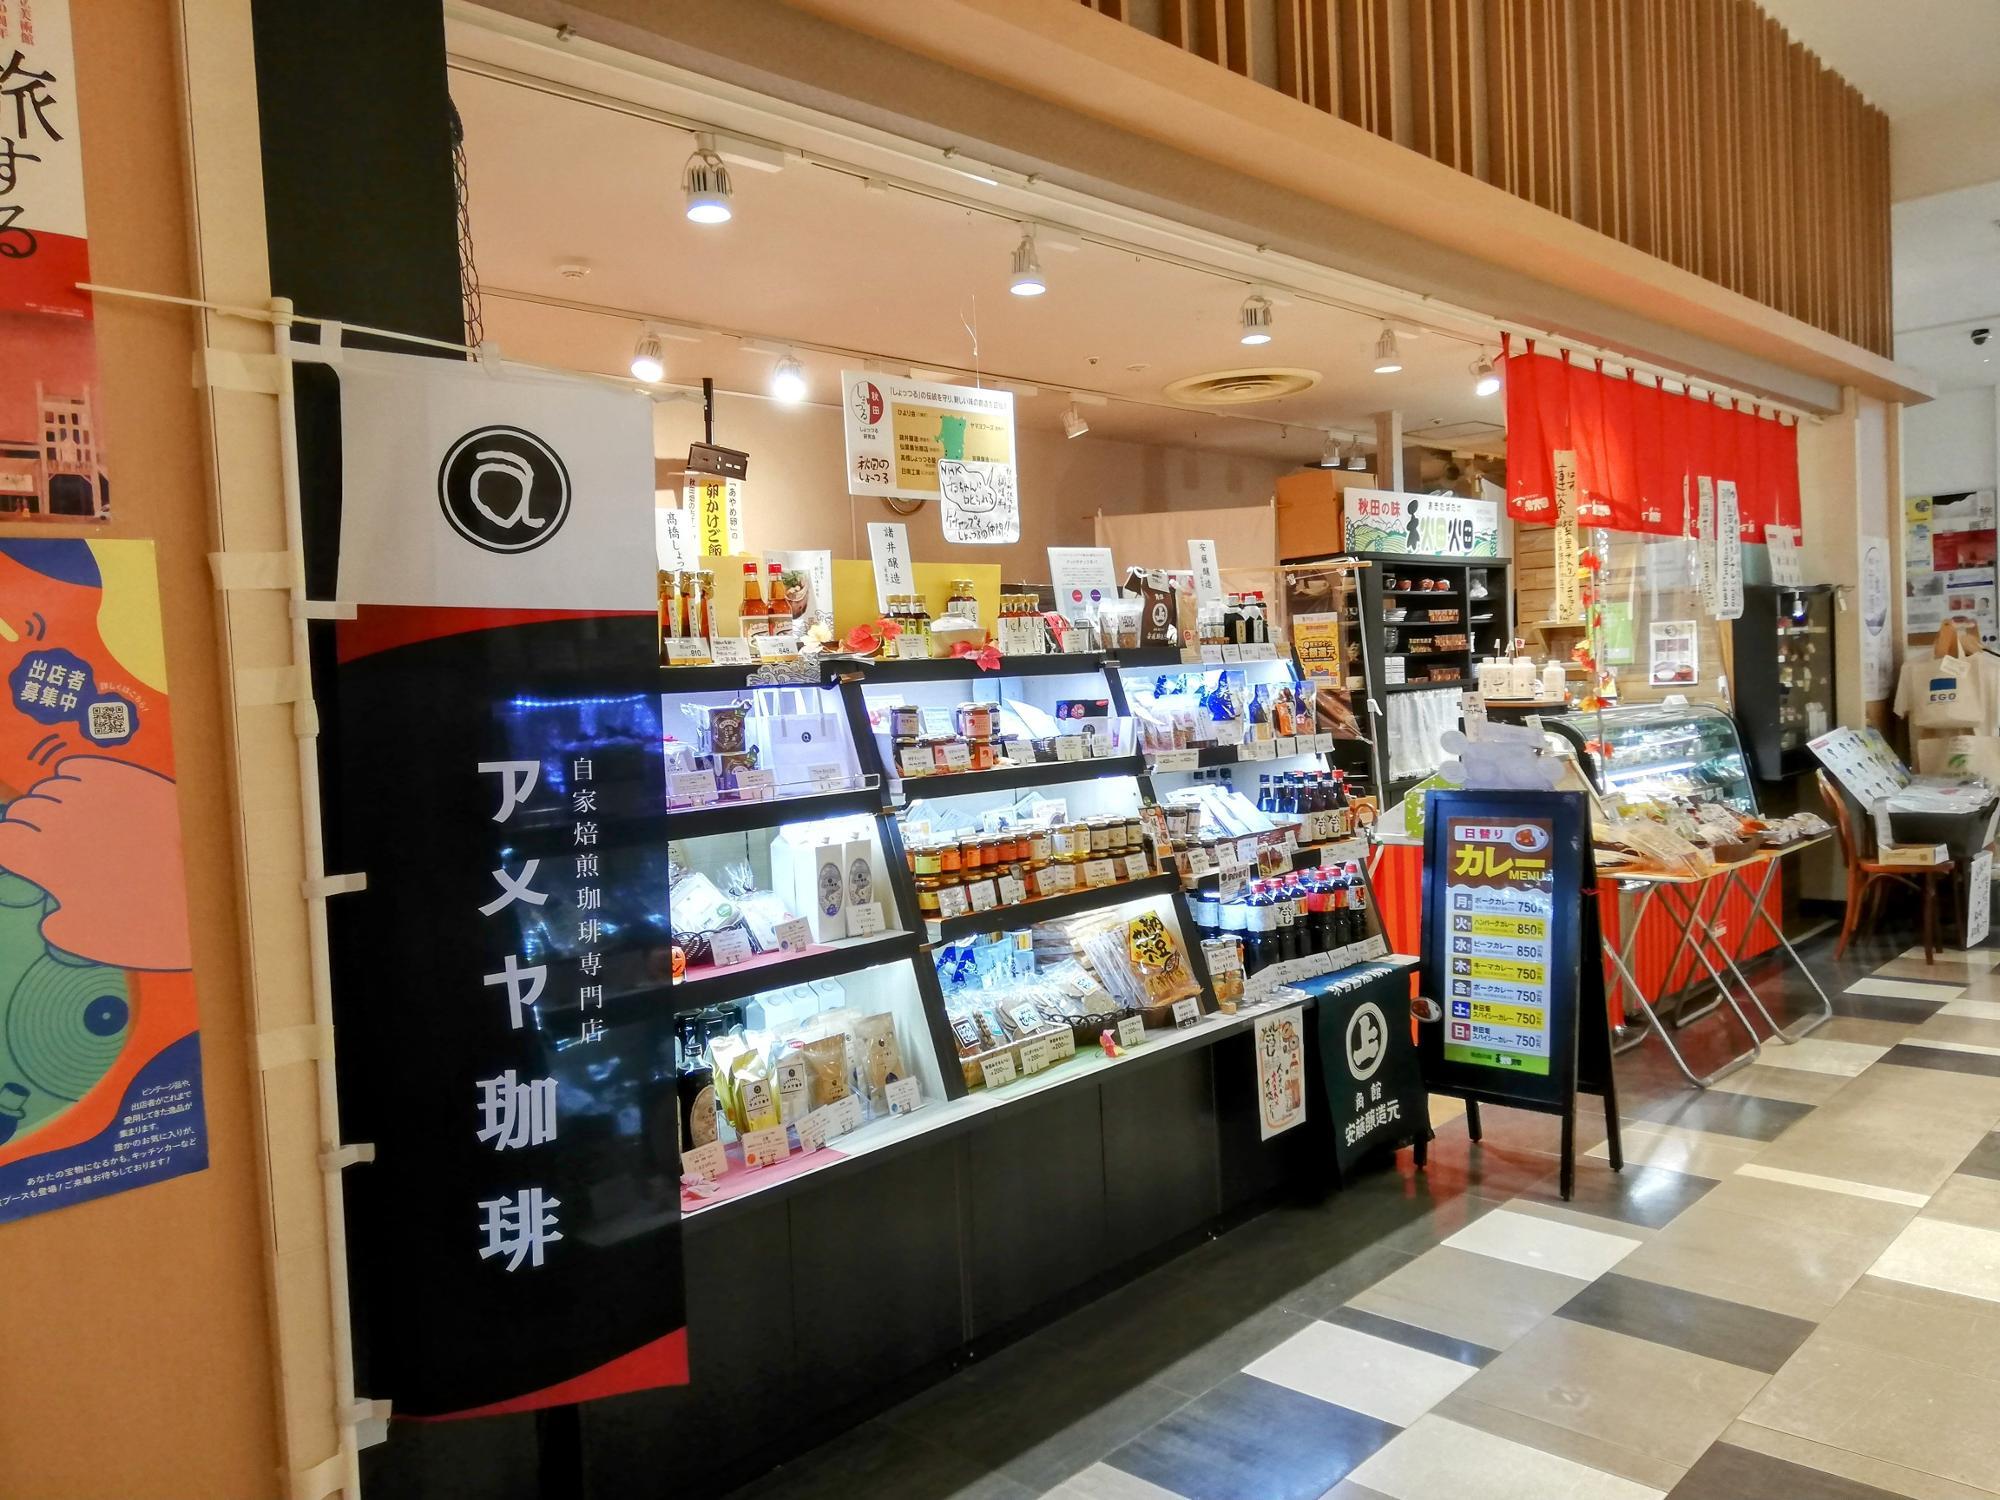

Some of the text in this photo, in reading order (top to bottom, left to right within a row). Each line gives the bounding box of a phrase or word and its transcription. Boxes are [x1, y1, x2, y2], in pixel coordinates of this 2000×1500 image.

[857, 455, 890, 471] 秋田の
[706, 483, 722, 556] 卵かけご飯
[1358, 497, 1401, 517] 秋田の味
[28, 659, 86, 691] 出店者
[21, 681, 78, 712] 募集中
[1930, 693, 1957, 702] EGO
[1465, 828, 1503, 839] 日替り
[1454, 844, 1545, 878] カレー
[1508, 870, 1549, 881] MENU
[571, 757, 604, 1045] 自家焙煎珈琲専門店
[476, 759, 566, 1273] アメヤ珈琲
[1355, 1081, 1383, 1112] 角館
